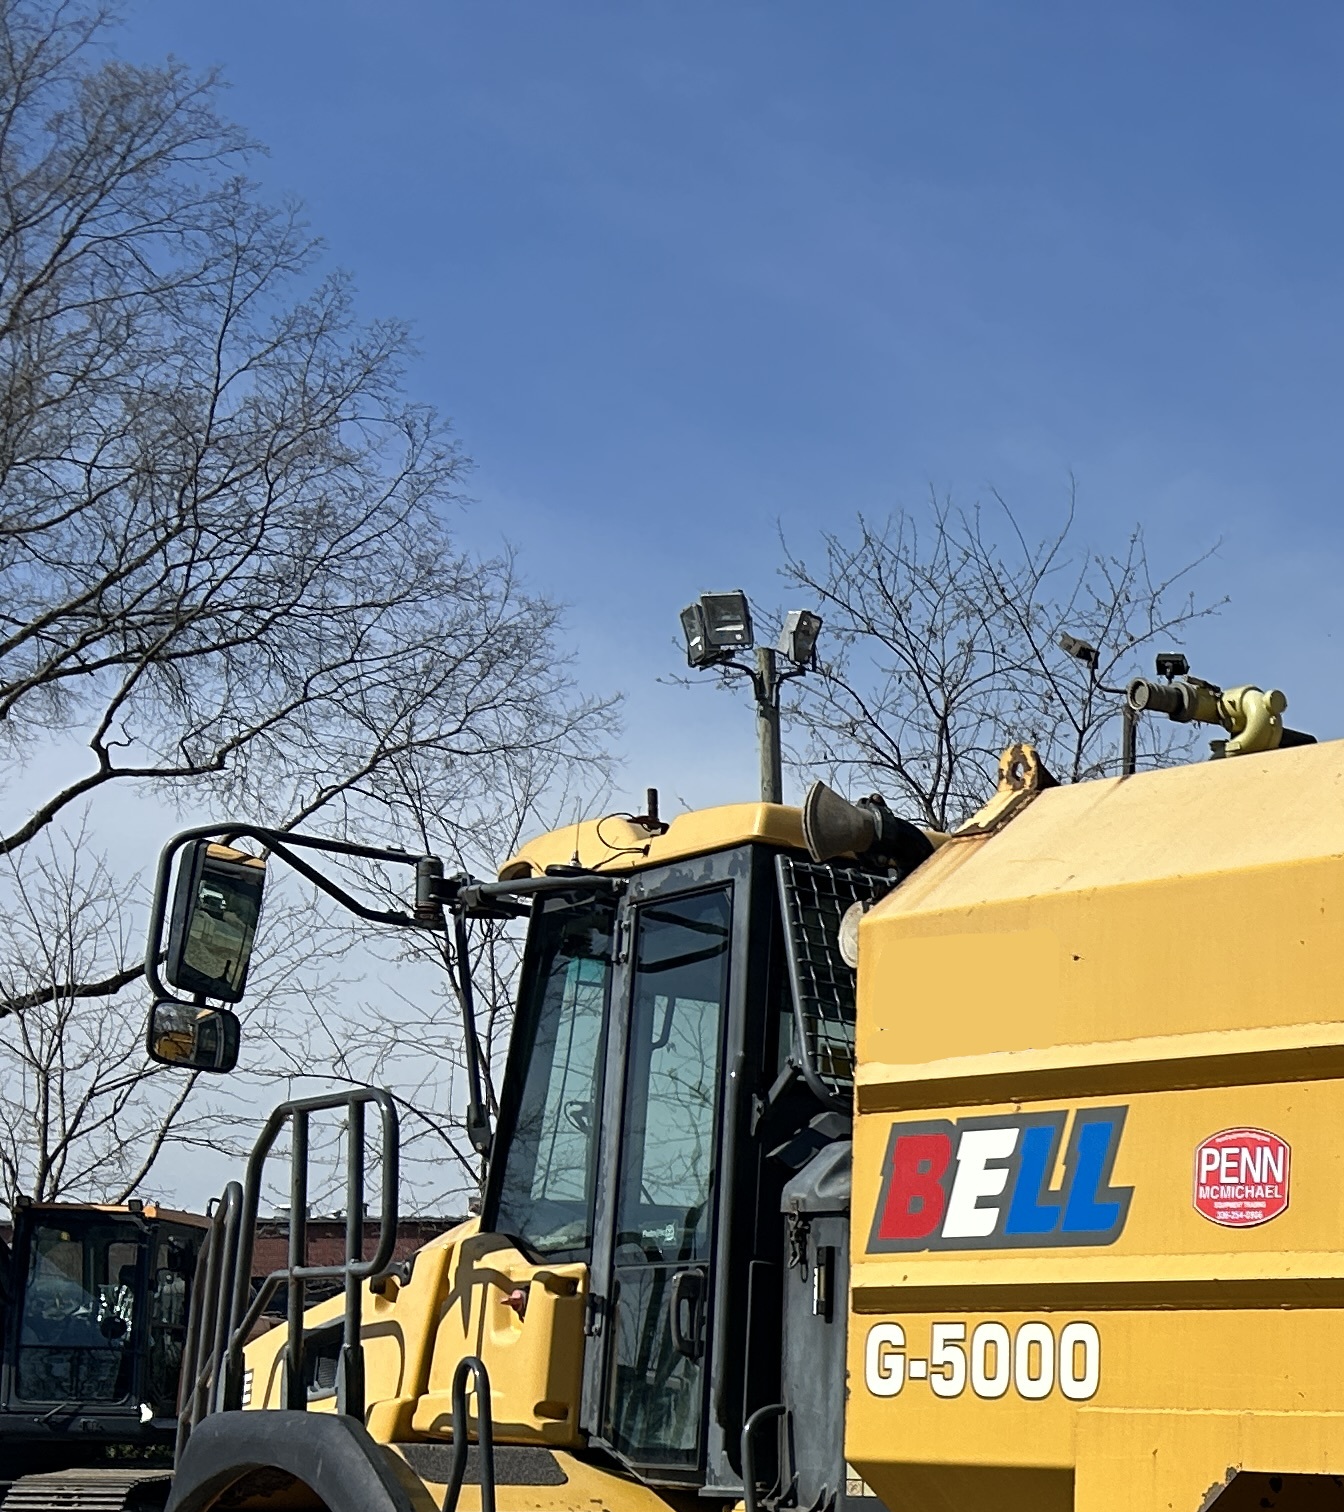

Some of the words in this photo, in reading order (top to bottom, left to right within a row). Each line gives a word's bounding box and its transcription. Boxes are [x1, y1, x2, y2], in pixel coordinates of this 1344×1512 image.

[873, 1117, 1126, 1242] BELL
[1198, 1184, 1283, 1200] MCMICHAEL
[1199, 1145, 1285, 1184] PENN
[865, 1321, 1101, 1400] G-5000
